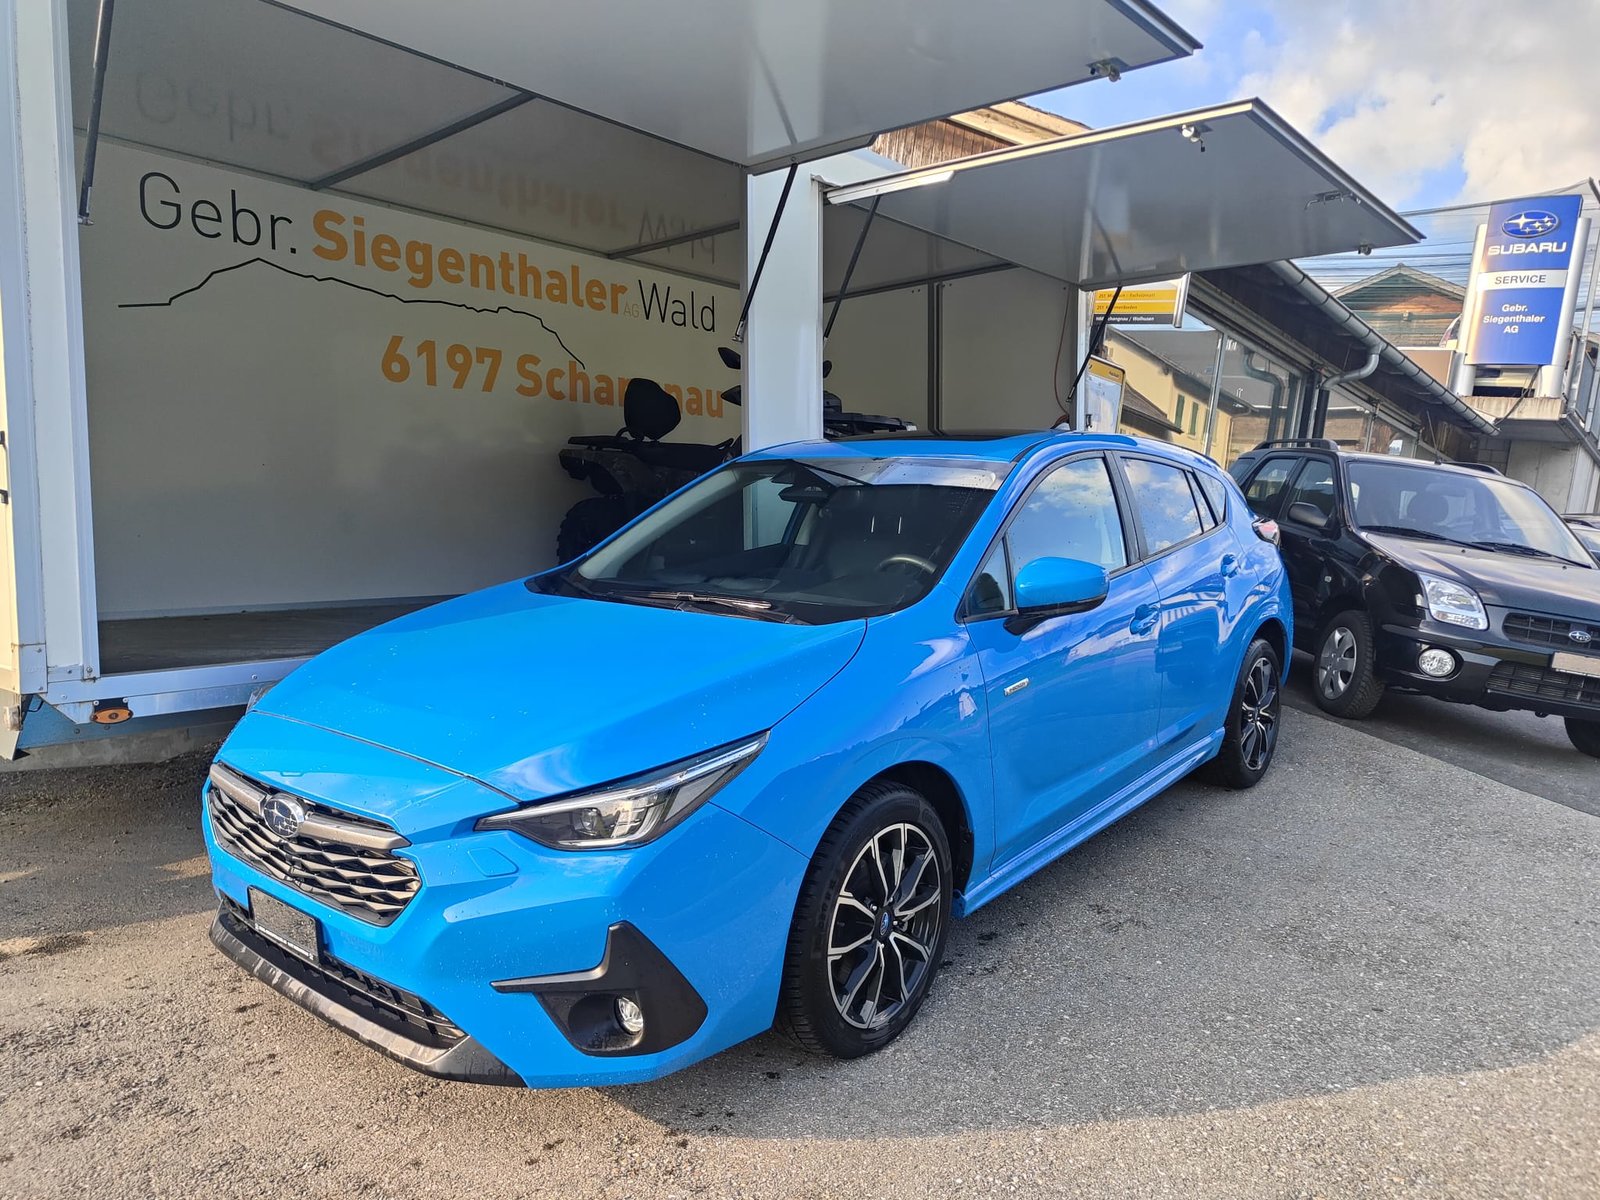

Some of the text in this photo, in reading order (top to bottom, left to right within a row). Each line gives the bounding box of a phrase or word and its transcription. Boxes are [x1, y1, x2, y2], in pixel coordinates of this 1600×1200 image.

[139, 171, 716, 332] Gebr. Siegenthaler AG Wald
[1487, 241, 1567, 256] SUBARU
[1494, 274, 1547, 285] SERVICE
[1501, 303, 1528, 313] Gebr.
[1483, 314, 1546, 326] Siegenthaler
[1503, 325, 1519, 334] AG
[381, 335, 502, 393] 6197
